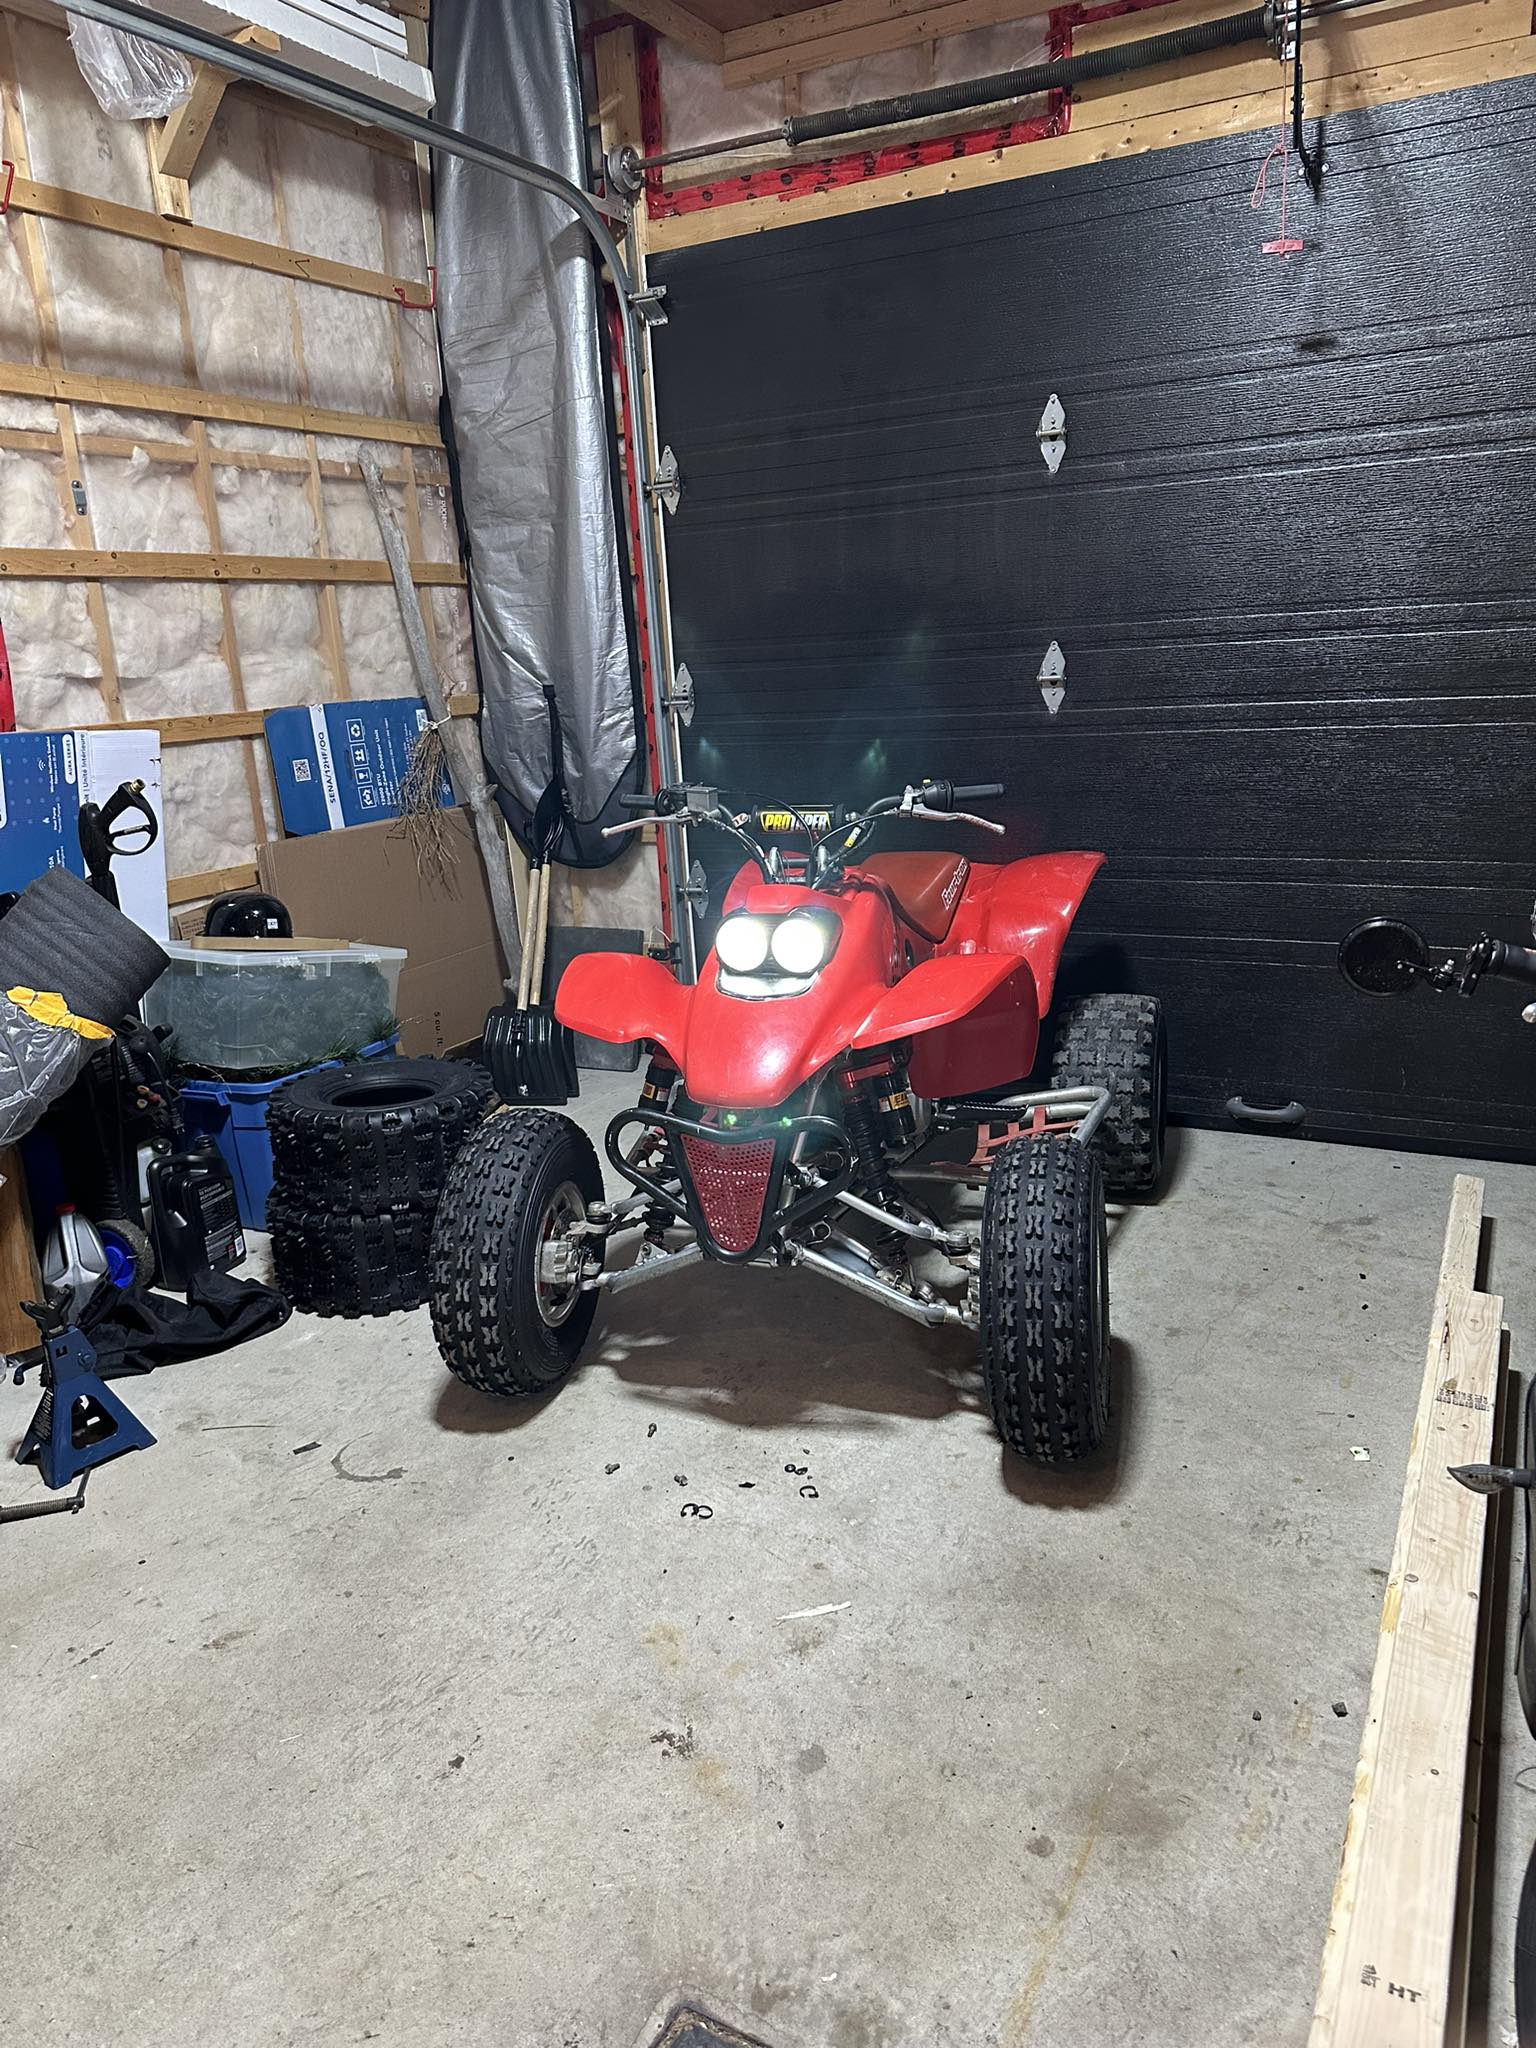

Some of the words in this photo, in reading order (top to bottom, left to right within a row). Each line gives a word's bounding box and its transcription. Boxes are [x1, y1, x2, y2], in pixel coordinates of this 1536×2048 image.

[80, 734, 88, 768] Intérieure
[376, 743, 385, 770] Outdoor
[318, 731, 337, 804] SENA/12HF/OQ
[1388, 1982, 1422, 2003] HT
